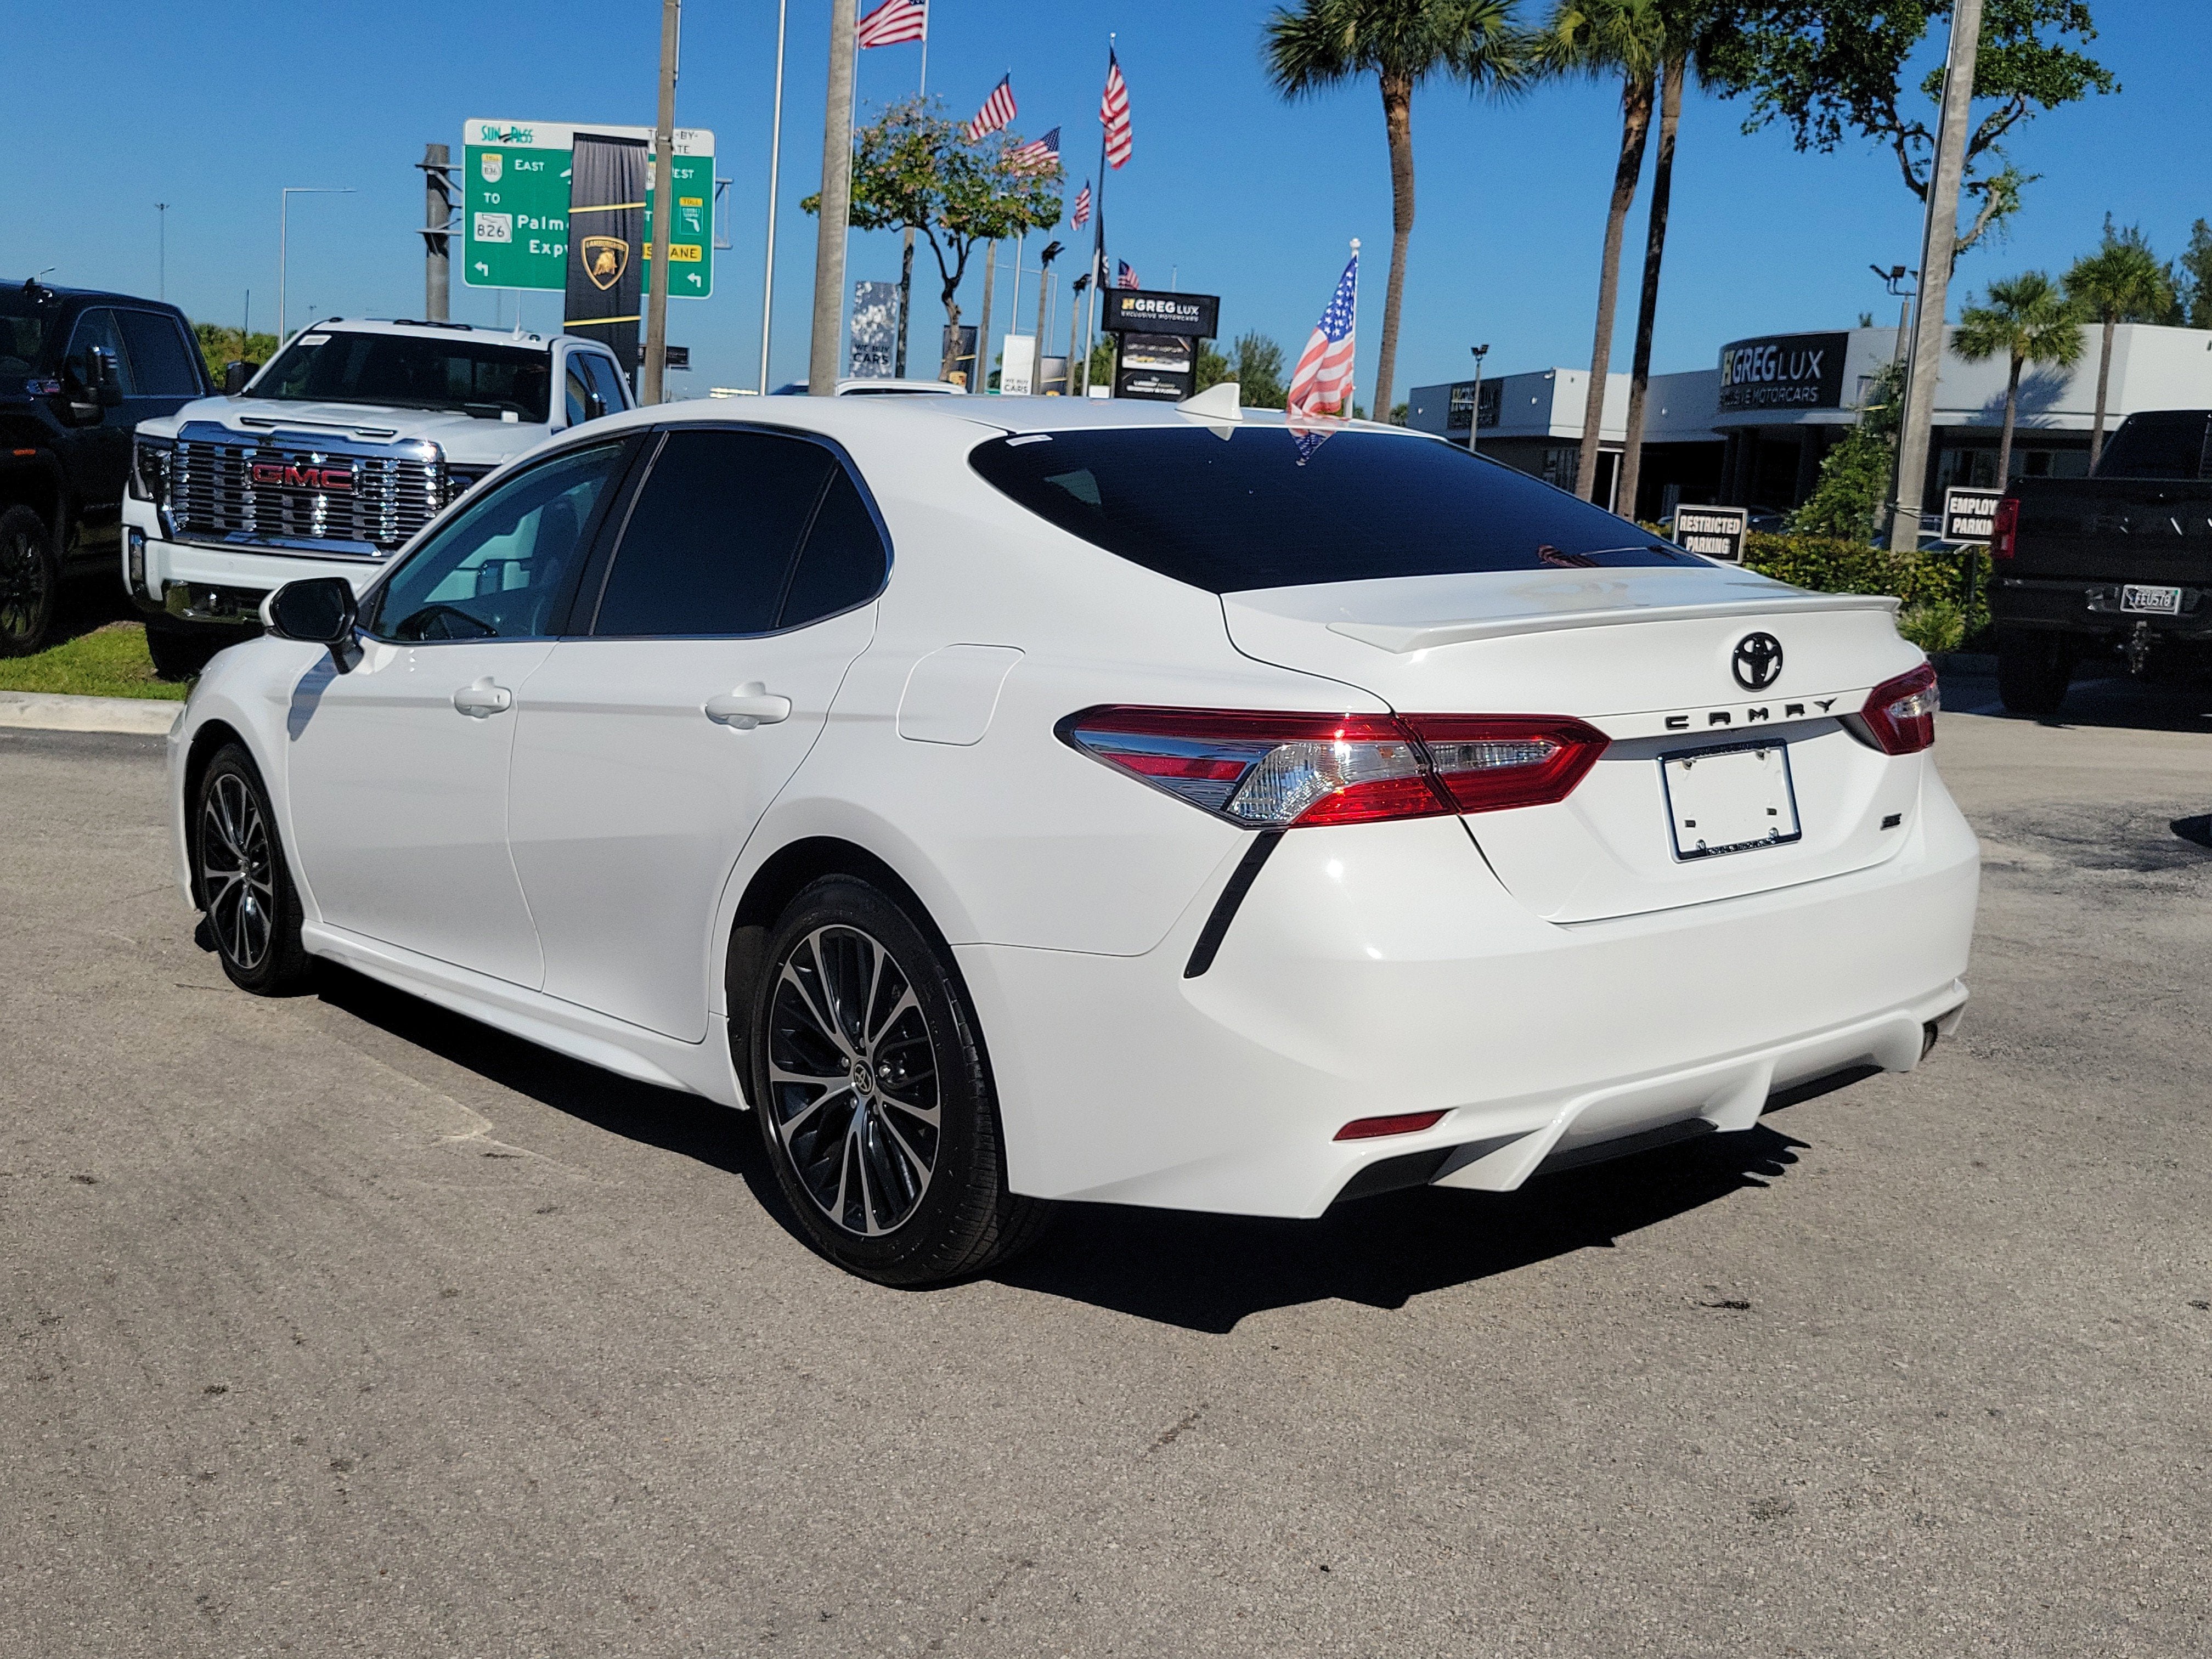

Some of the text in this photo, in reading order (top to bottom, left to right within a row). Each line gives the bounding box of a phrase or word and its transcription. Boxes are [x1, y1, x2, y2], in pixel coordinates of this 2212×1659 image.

[515, 159, 545, 171] EAST
[672, 168, 694, 179] EST
[483, 192, 500, 204] TO
[517, 215, 569, 230] Palm
[477, 224, 505, 238] 826
[529, 239, 568, 258] Exp
[670, 248, 698, 258] ANE
[853, 352, 889, 365] CARS
[1004, 384, 1029, 393] CARS
[252, 464, 353, 490] GMC
[1950, 496, 1999, 516] EMPLOY
[1680, 515, 1741, 534] RESTRICTED
[1952, 517, 1993, 536] PARKIN
[1685, 535, 1731, 555] PARKING
[1665, 697, 1837, 730] CAMRY
